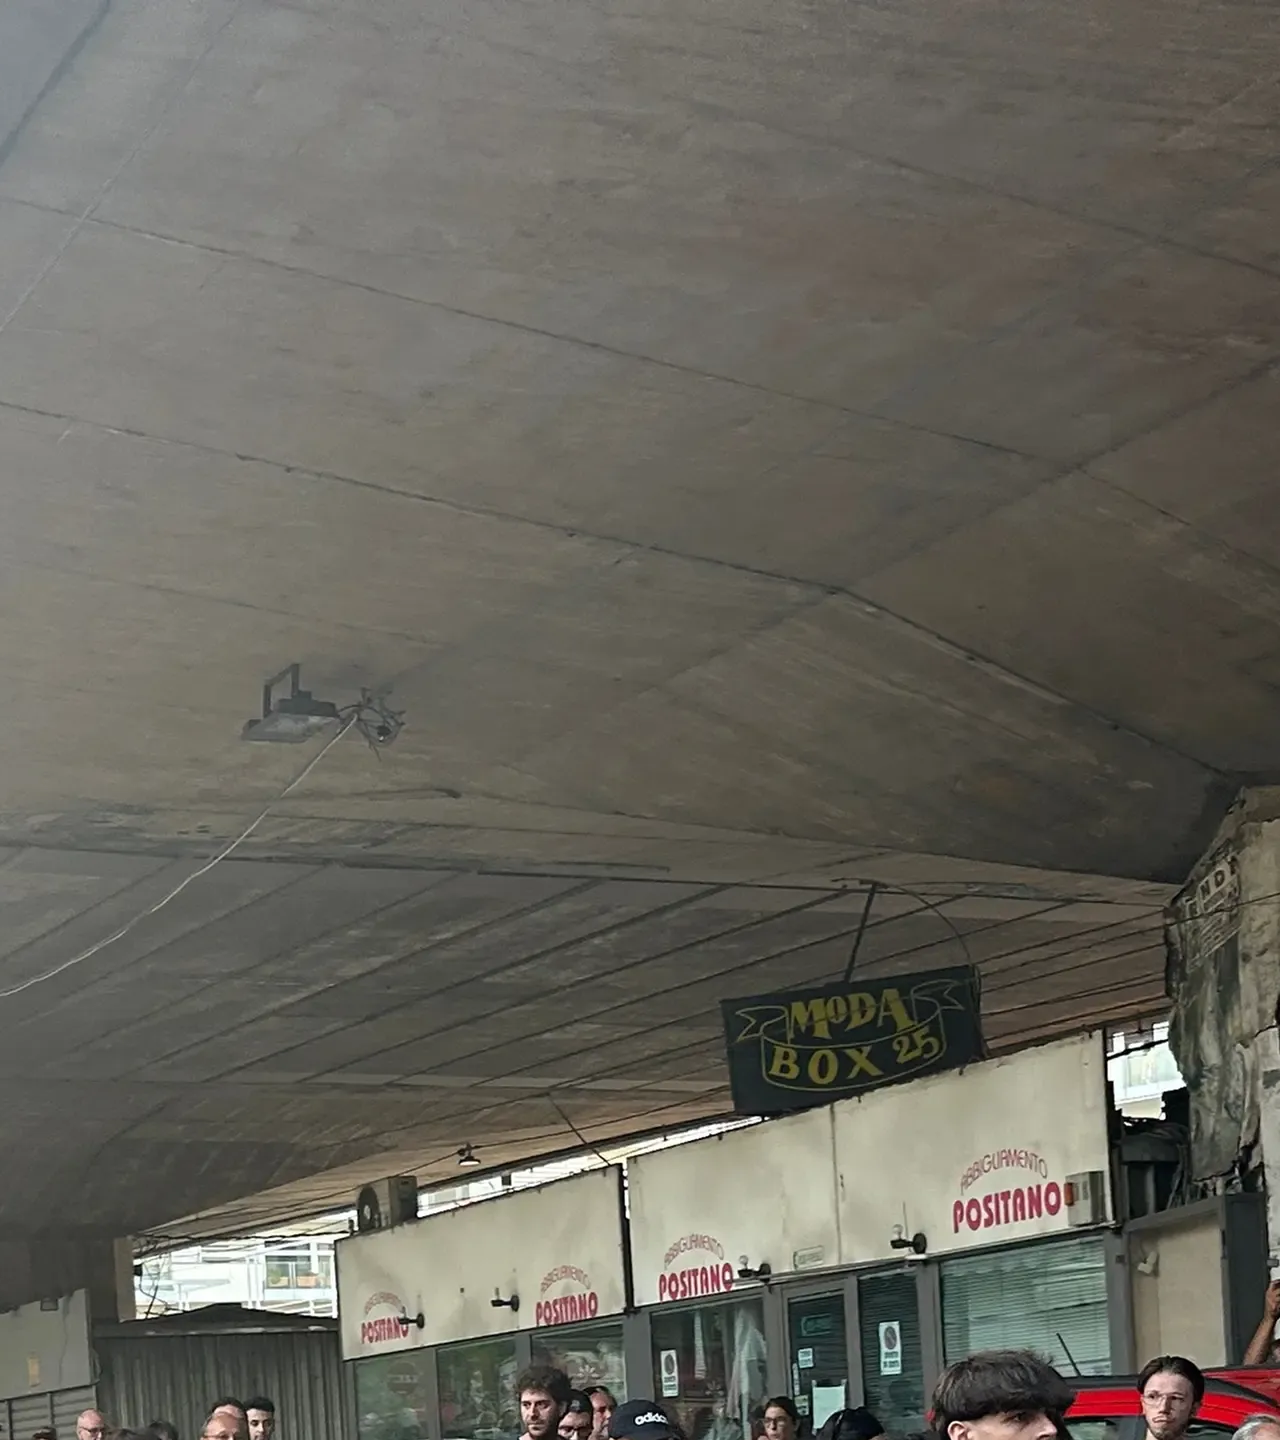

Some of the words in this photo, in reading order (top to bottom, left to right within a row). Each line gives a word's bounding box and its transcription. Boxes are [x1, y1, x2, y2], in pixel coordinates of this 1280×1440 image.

[787, 987, 919, 1041] MODA
[769, 1045, 885, 1085] BOX
[892, 1026, 942, 1065] 25
[952, 1180, 1063, 1234] POSITANO
[535, 1291, 599, 1328] POSITANO
[658, 1262, 735, 1304] POSITANO
